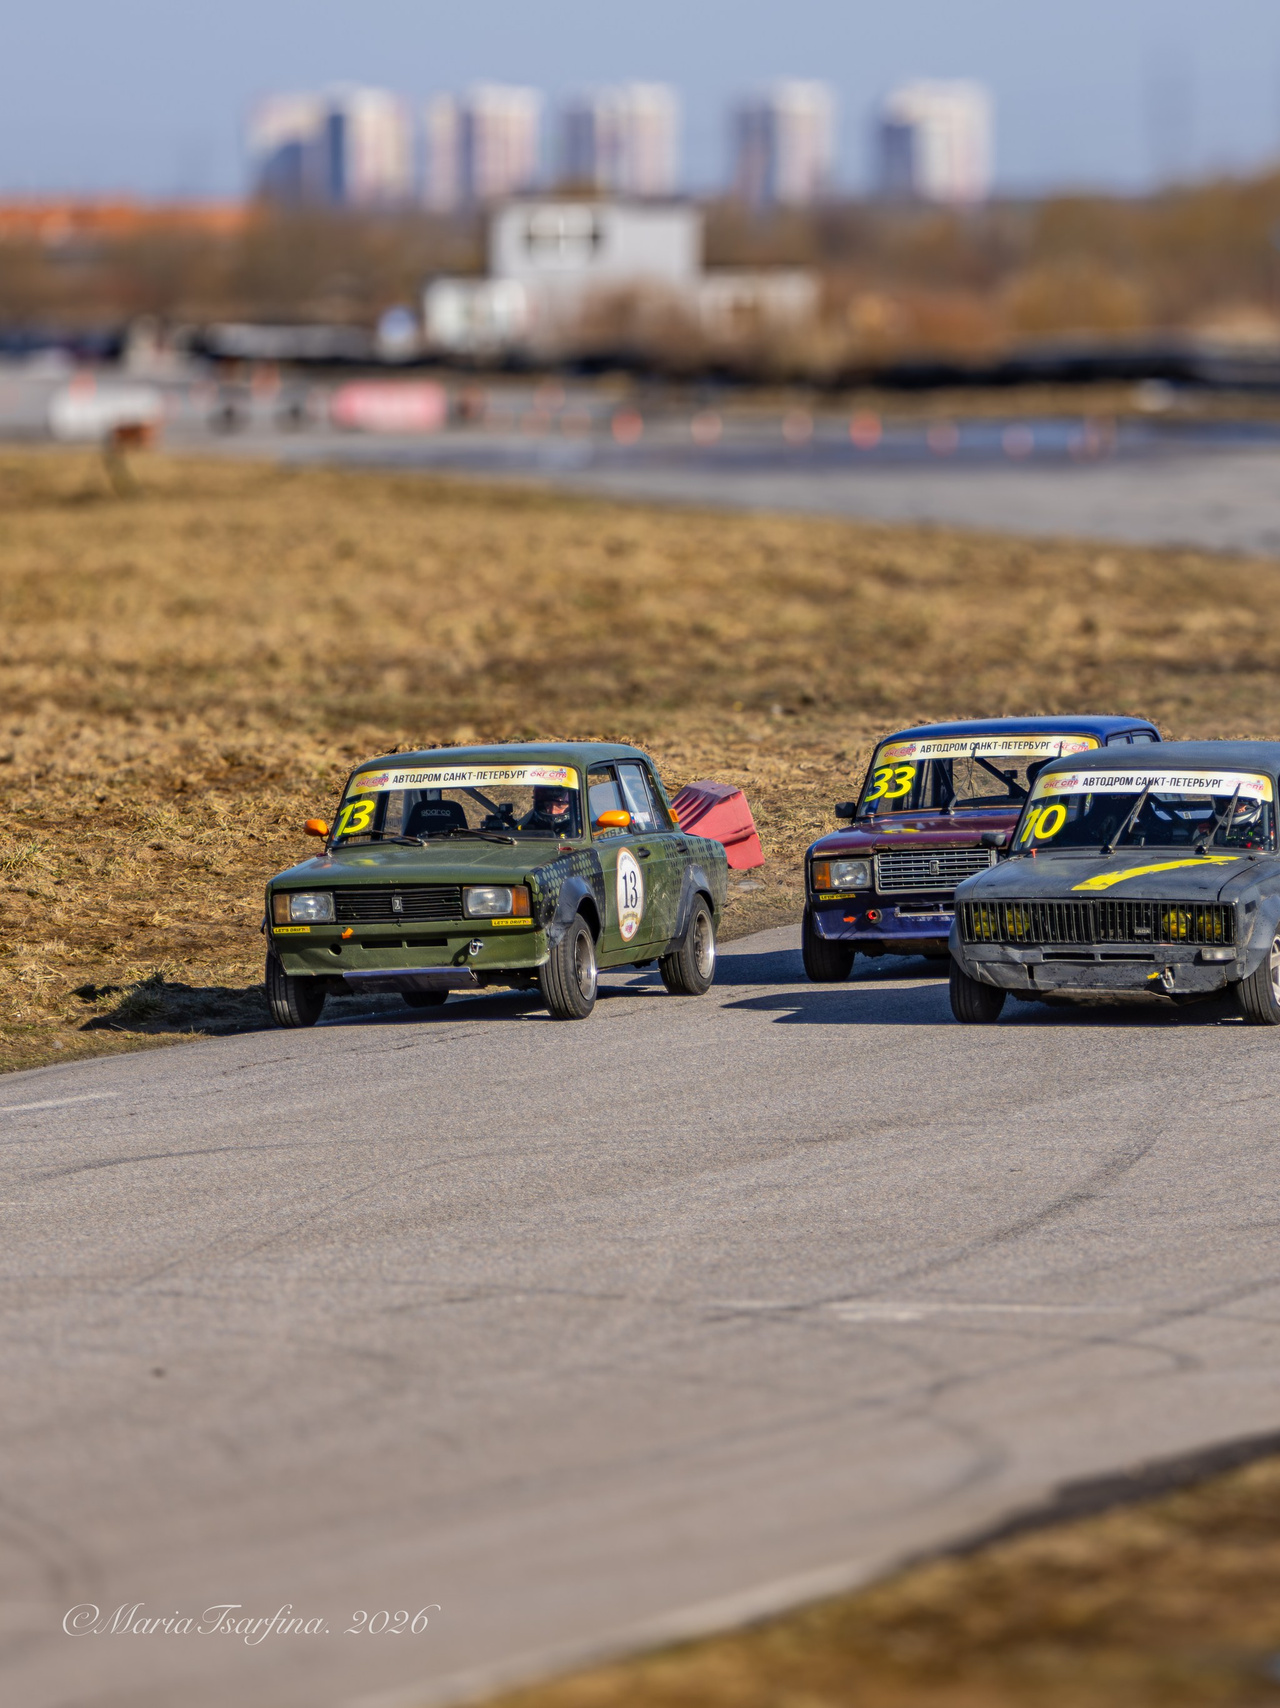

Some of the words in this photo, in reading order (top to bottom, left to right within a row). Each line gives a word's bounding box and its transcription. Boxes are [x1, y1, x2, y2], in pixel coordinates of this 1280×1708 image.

[920, 742, 968, 753] АВТОДРОМ
[969, 741, 1051, 751] САНКТ-ПЕТЕРБУРГ
[392, 772, 441, 784] АВТОДРОМ
[443, 769, 528, 782] САНКТ-ПЕТЕРБУРГ
[864, 765, 916, 803] 33
[1082, 776, 1133, 787] АВТОДРОМ
[1135, 776, 1223, 789] САНКТ-ПЕТЕРБУРГ
[335, 799, 376, 837] 13
[1020, 804, 1067, 843] 10
[622, 870, 638, 909] 13
